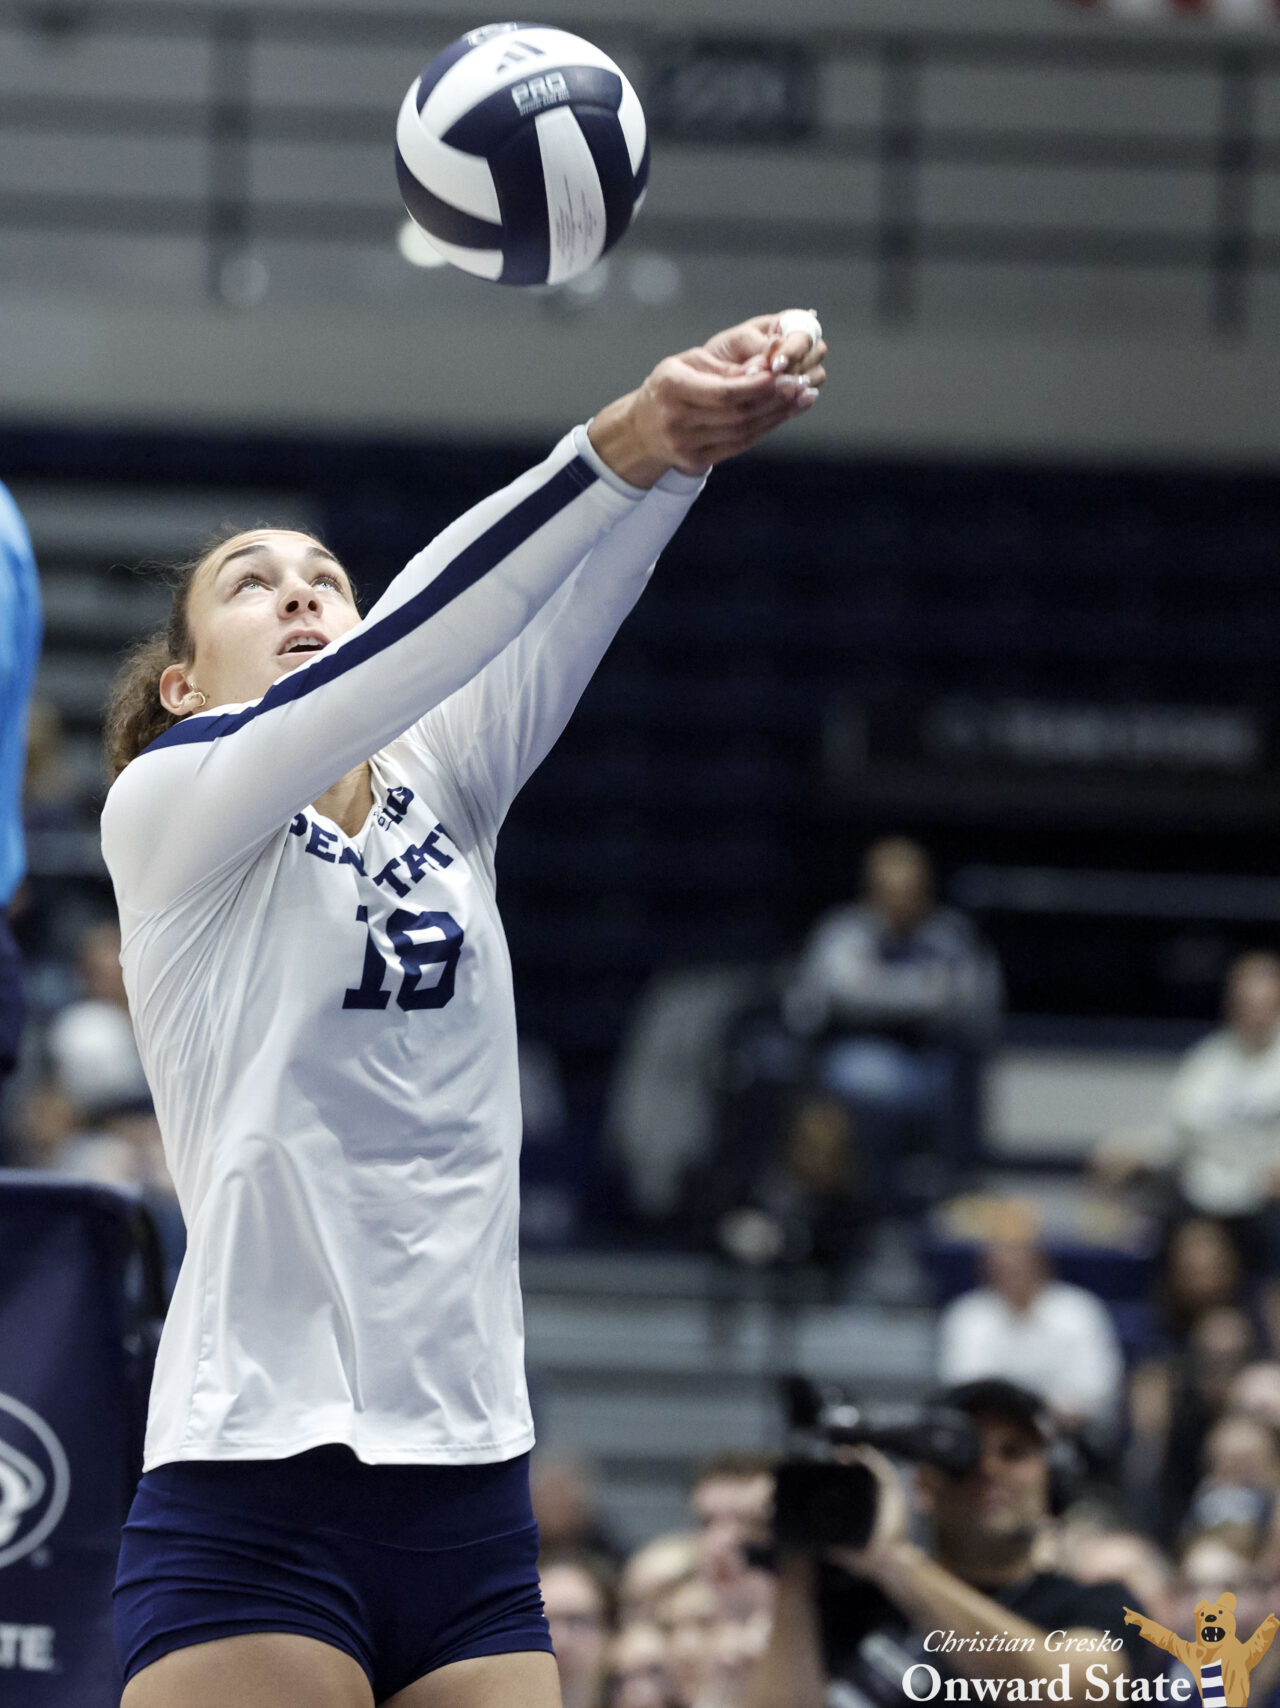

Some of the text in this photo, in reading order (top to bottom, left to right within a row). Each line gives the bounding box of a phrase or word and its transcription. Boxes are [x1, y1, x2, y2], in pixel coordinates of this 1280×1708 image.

[289, 812, 454, 898] PEN TAT
[342, 904, 464, 1012] 18
